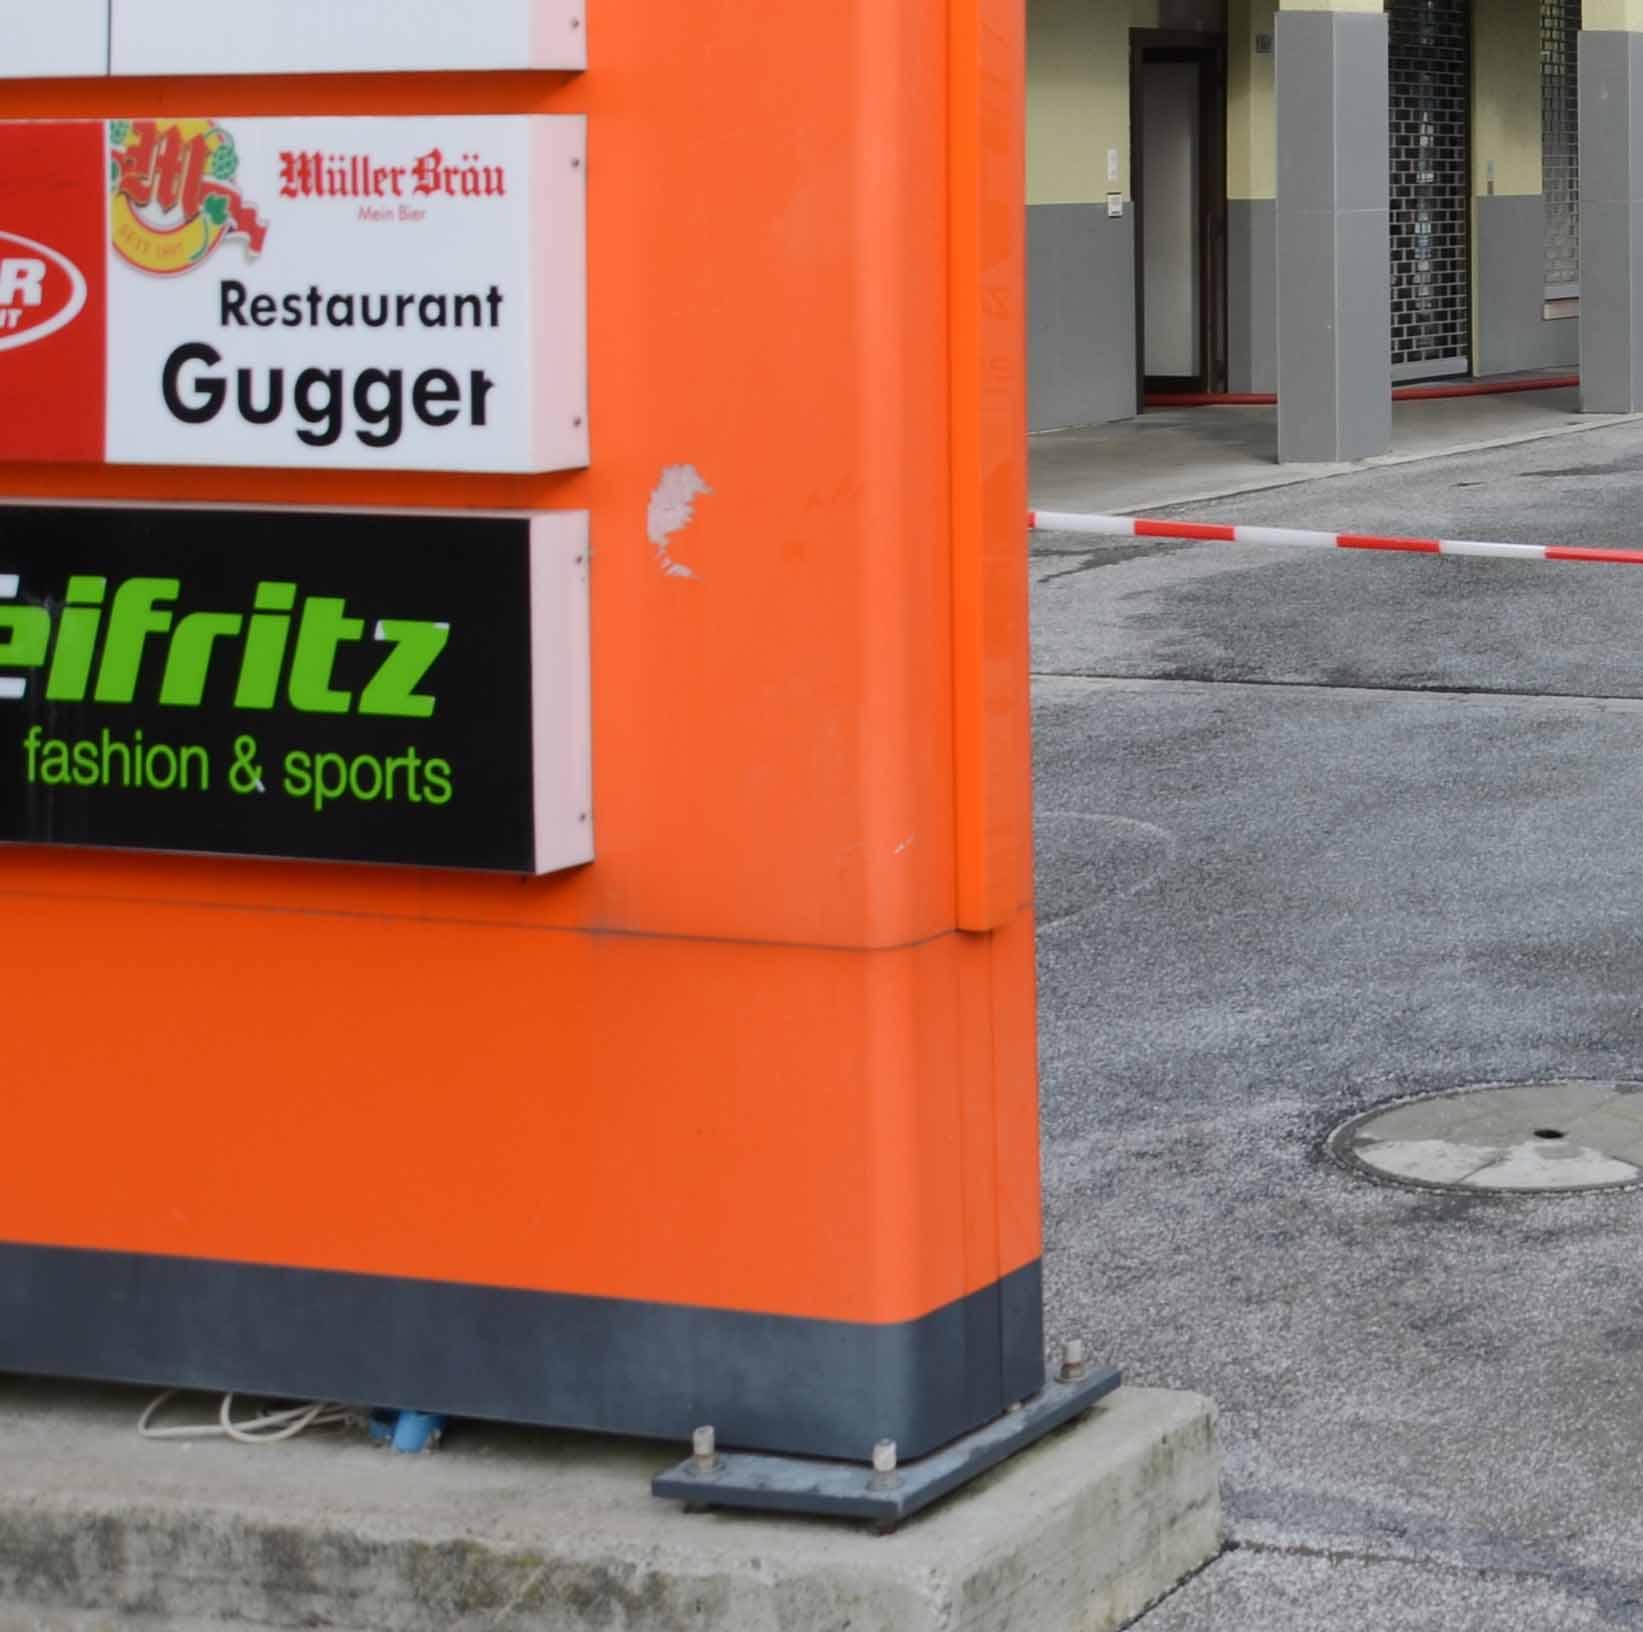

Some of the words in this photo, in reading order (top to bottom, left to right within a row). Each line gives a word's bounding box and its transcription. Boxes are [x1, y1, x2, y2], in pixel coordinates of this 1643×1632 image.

[279, 149, 406, 198] Müller
[410, 146, 507, 198] Bräu
[356, 205, 395, 222] Mein
[399, 204, 427, 222] Bier
[219, 279, 504, 328] Restaurant
[161, 341, 495, 449] Gugger
[24, 725, 209, 791] fashion
[229, 734, 266, 793] &
[283, 745, 453, 812] sports
